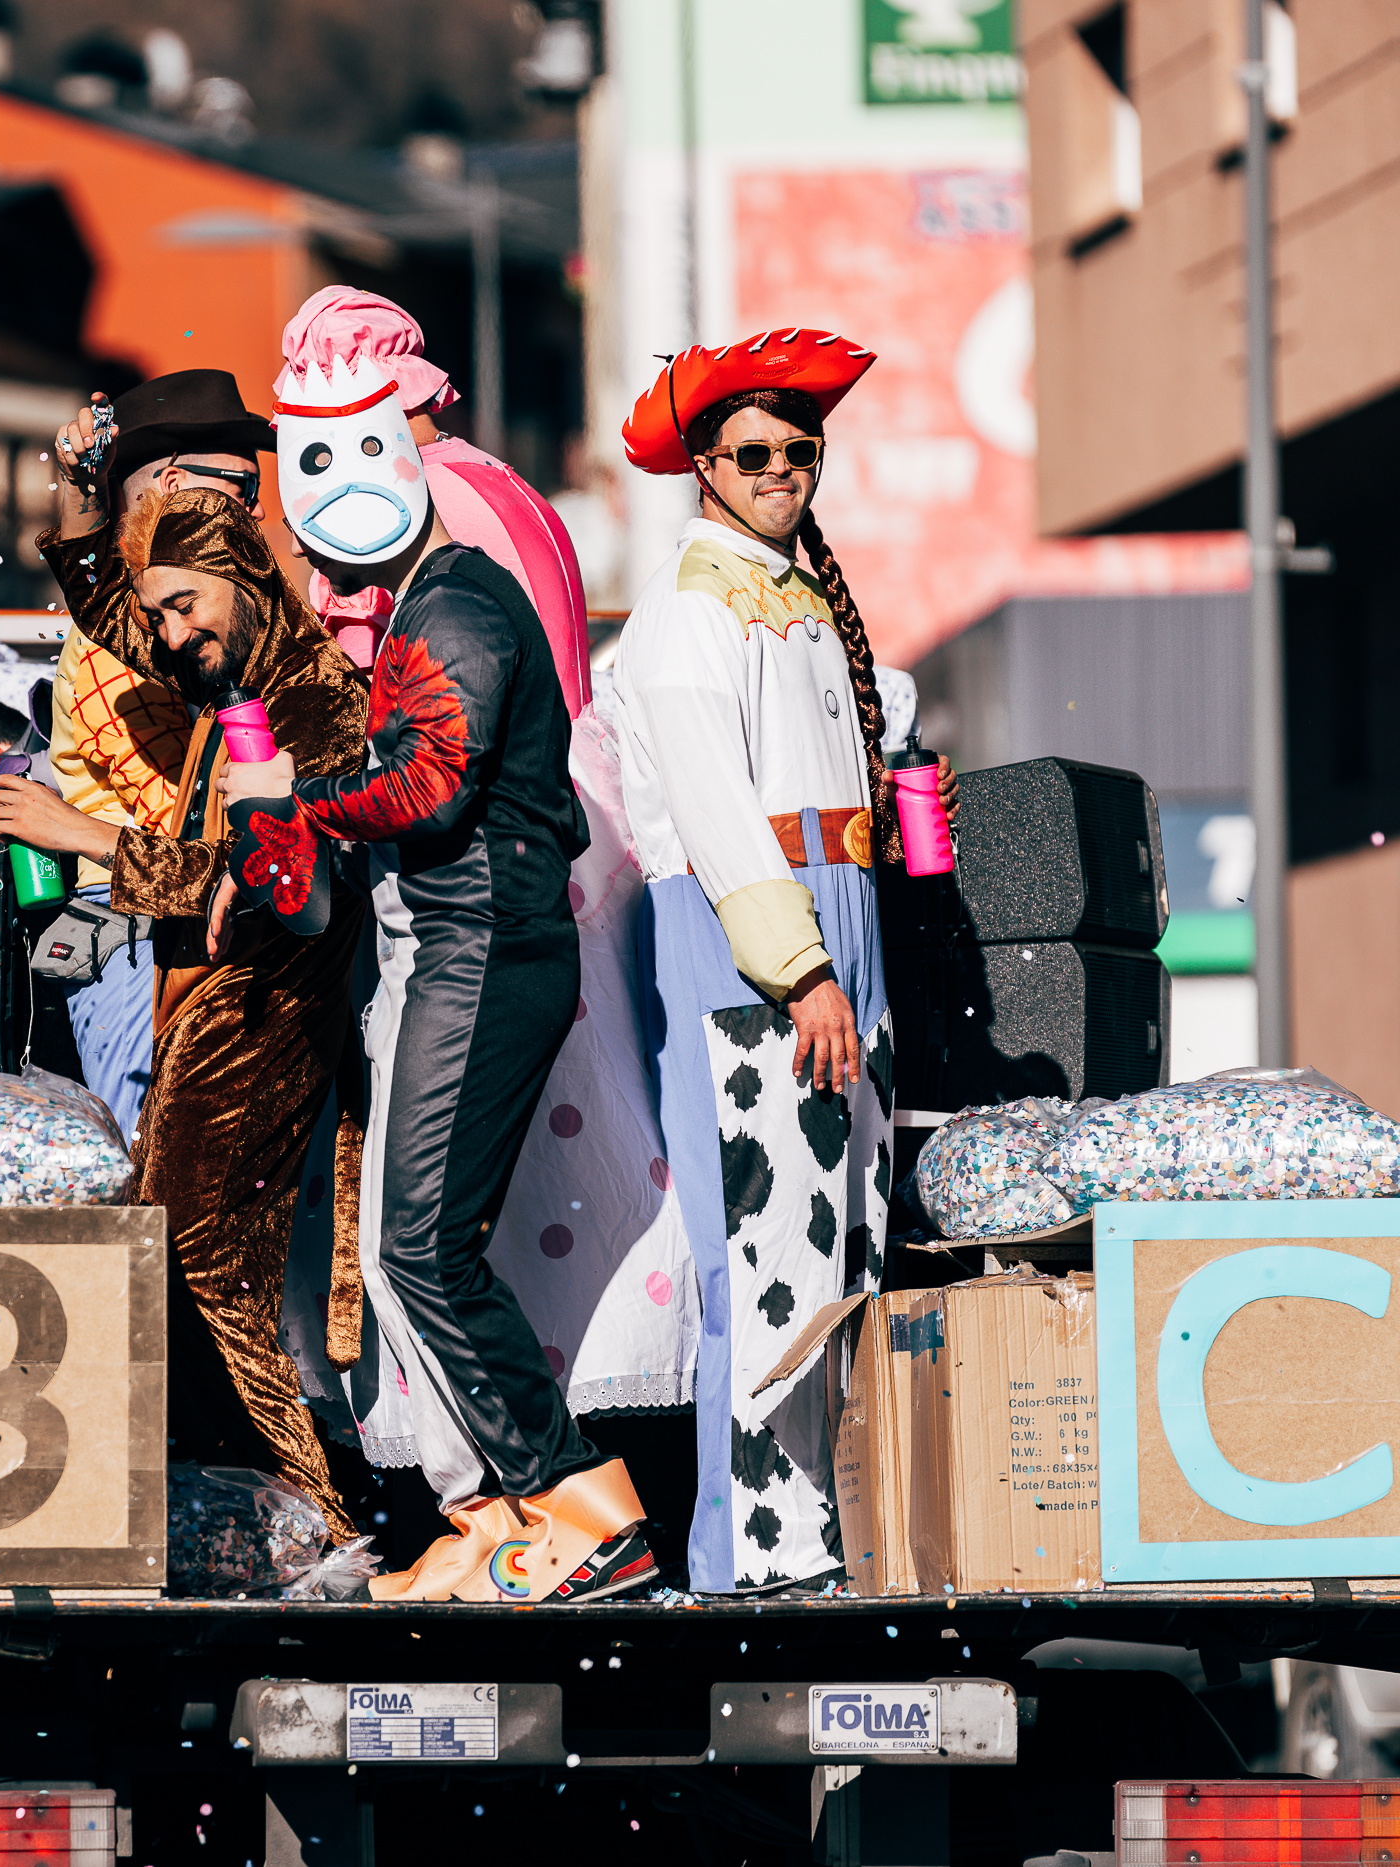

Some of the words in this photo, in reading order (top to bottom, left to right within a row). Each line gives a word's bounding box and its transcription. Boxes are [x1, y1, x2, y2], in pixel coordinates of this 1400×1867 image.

[1009, 1381, 1035, 1390] Item
[1056, 1378, 1082, 1388] 3837
[1157, 1245, 1393, 1526] C
[1010, 1415, 1035, 1427] Qty:
[1058, 1412, 1077, 1423] 100
[1011, 1431, 1042, 1441] G.W.:
[1059, 1428, 1065, 1438] 6
[1074, 1427, 1089, 1439] kg
[1011, 1447, 1042, 1457] N.W.:
[1061, 1445, 1068, 1454] 5
[1075, 1443, 1089, 1455] kg
[1047, 1480, 1085, 1490] Batch:
[1043, 1501, 1075, 1511] made
[1077, 1500, 1088, 1510] in
[821, 1741, 880, 1749] BARCELONA
